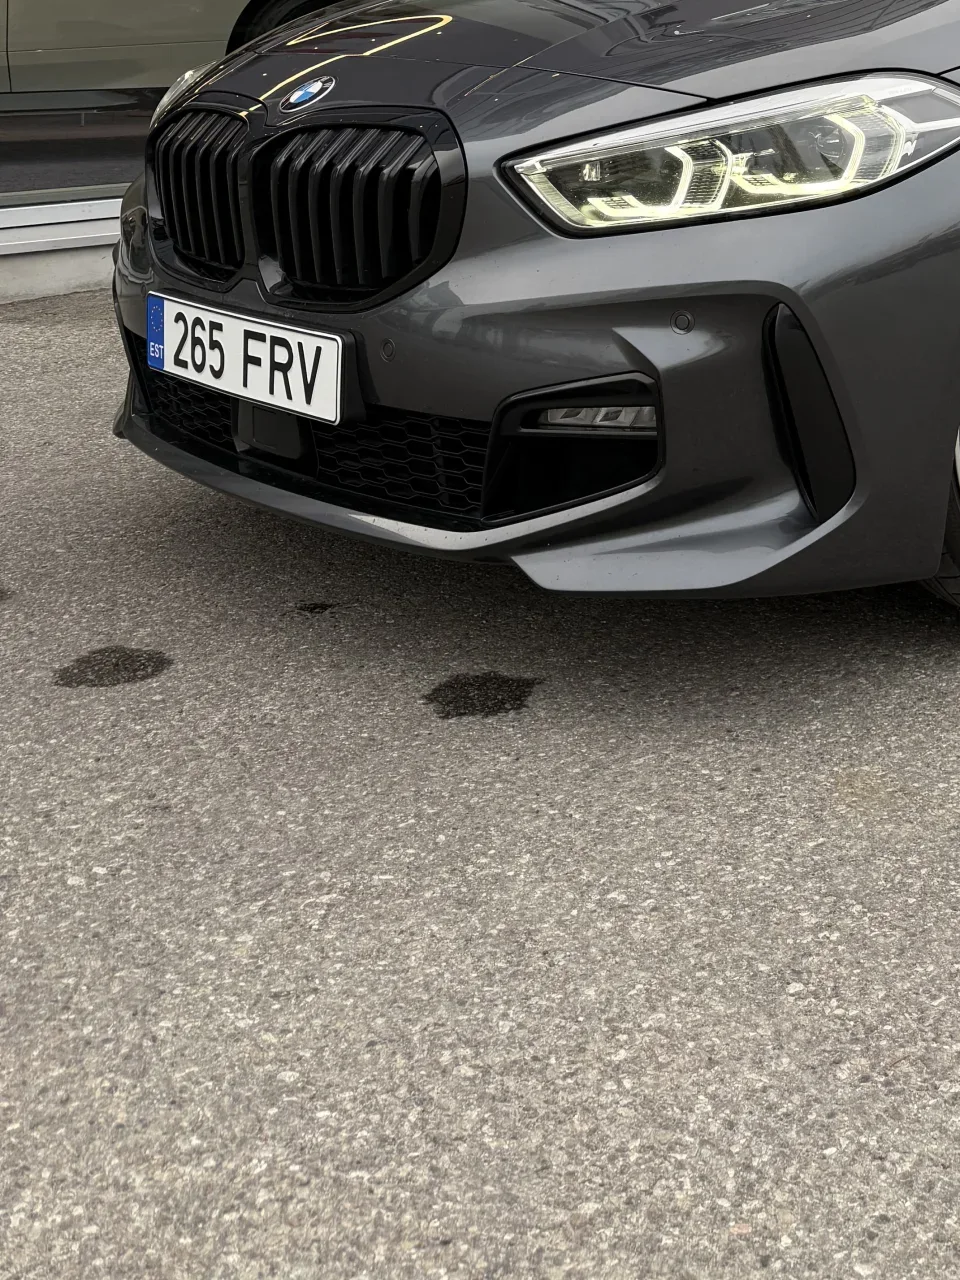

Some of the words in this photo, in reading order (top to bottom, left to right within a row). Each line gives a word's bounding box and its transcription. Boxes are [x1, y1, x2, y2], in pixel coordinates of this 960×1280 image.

[149, 341, 164, 359] EST
[173, 311, 225, 380] 265
[242, 328, 322, 405] FRV
